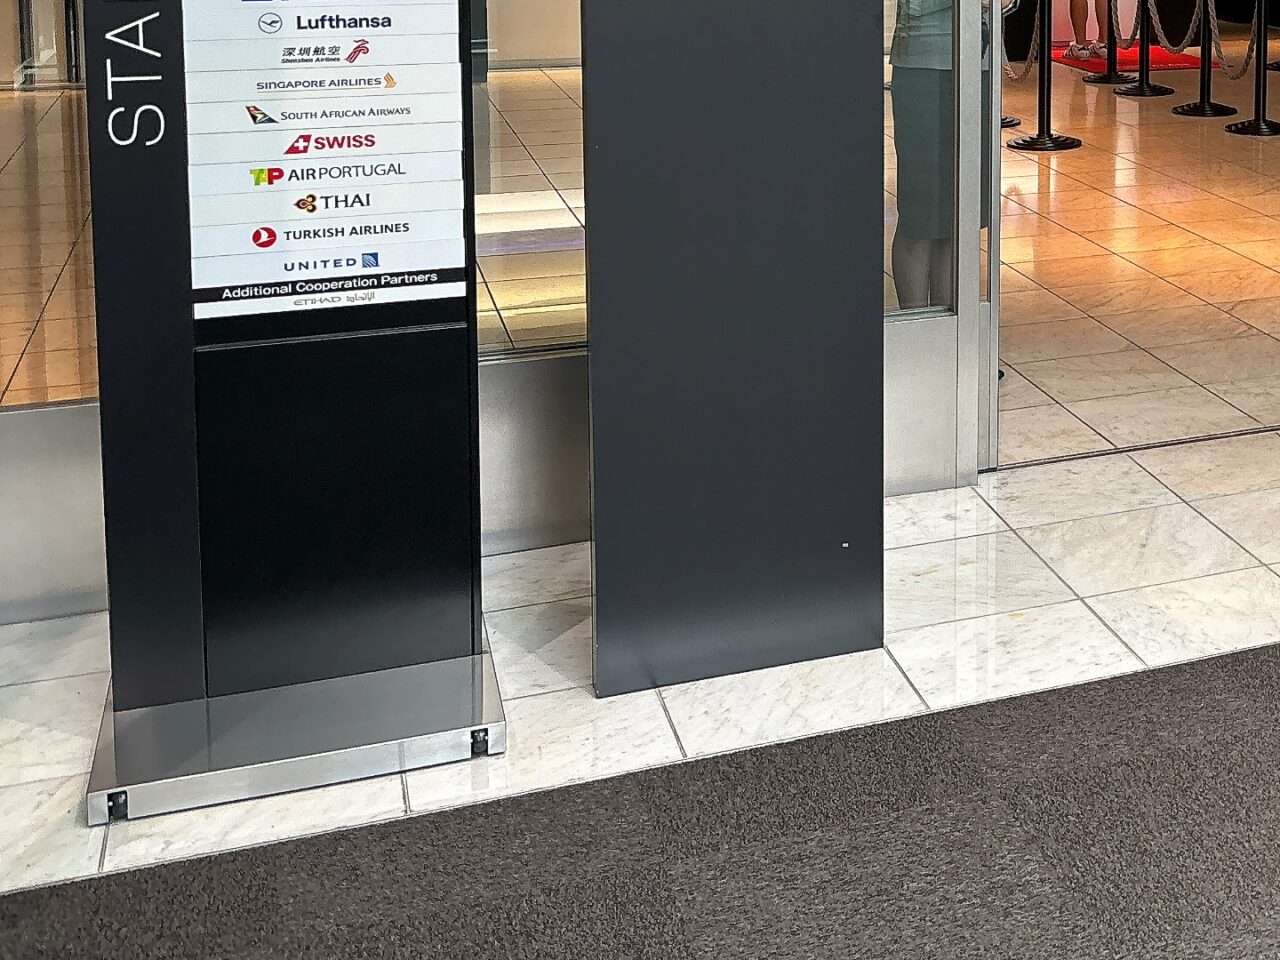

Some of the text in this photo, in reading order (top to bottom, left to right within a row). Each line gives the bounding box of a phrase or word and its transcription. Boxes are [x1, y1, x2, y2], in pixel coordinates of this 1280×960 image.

[296, 15, 392, 30] Lufthansa
[282, 45, 341, 57] 深圳航空
[256, 77, 382, 90] SINGAPORE AIRLINES
[280, 106, 411, 121] SOUTH AFRICAN AIRWAYS
[314, 134, 376, 150] SWISS
[320, 193, 371, 210] THAI
[284, 222, 410, 241] TURKISH AIRLINES
[284, 257, 357, 272] UNITED
[222, 272, 438, 300] Additional Cooperation Partners
[293, 296, 341, 306] ETIHAD
